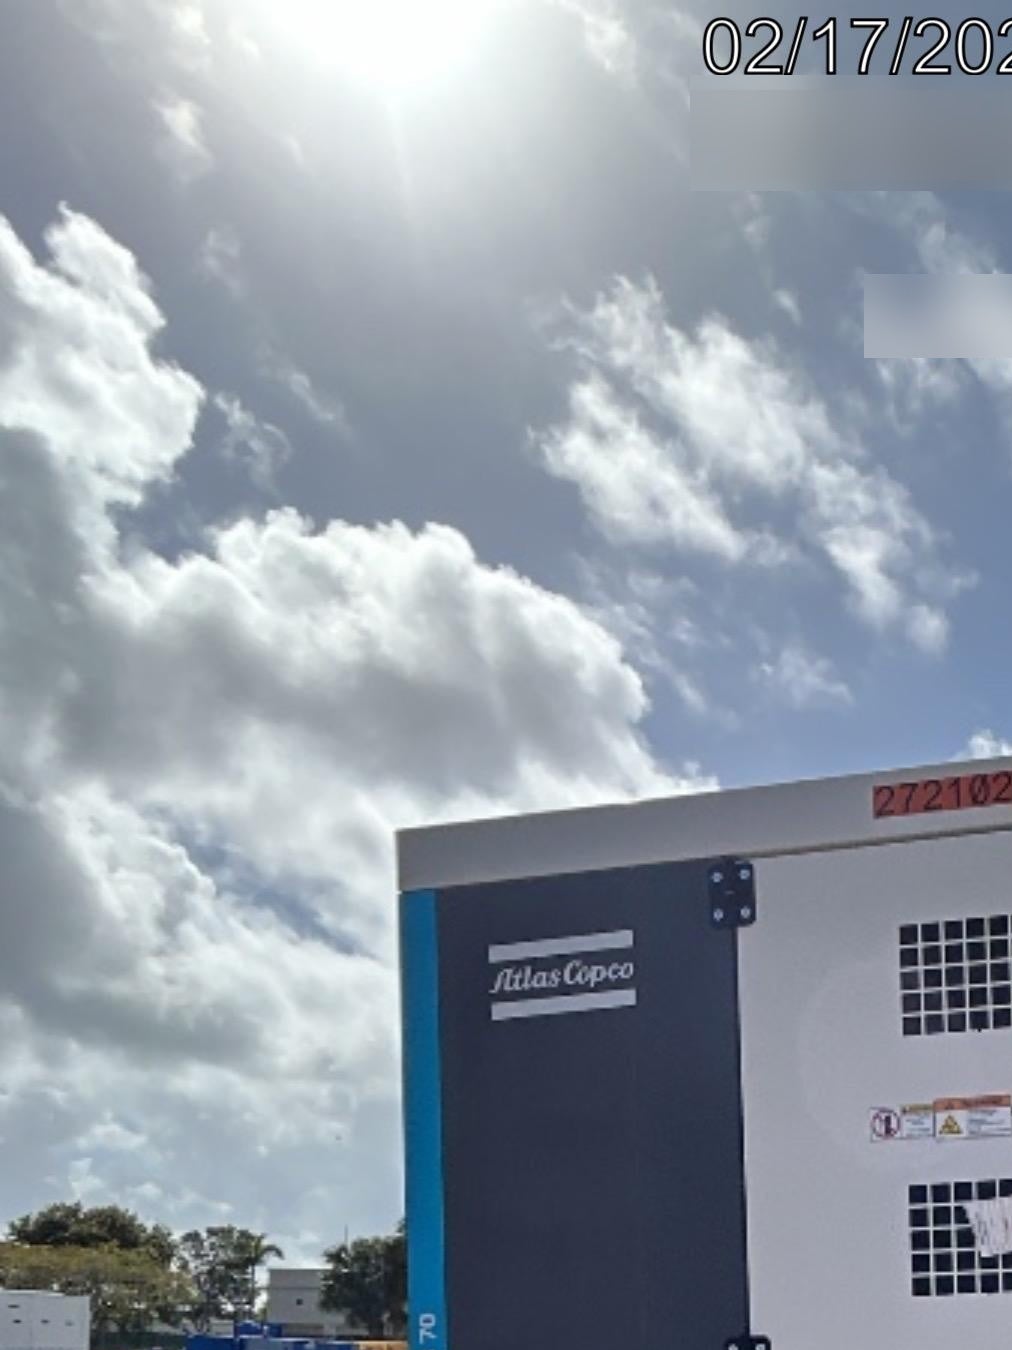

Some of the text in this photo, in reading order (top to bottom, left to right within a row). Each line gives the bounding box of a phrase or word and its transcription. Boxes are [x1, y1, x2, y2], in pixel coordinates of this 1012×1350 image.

[874, 772, 1012, 818] 272102
[488, 960, 634, 994] Atlas Copco
[419, 1312, 438, 1345] 70
